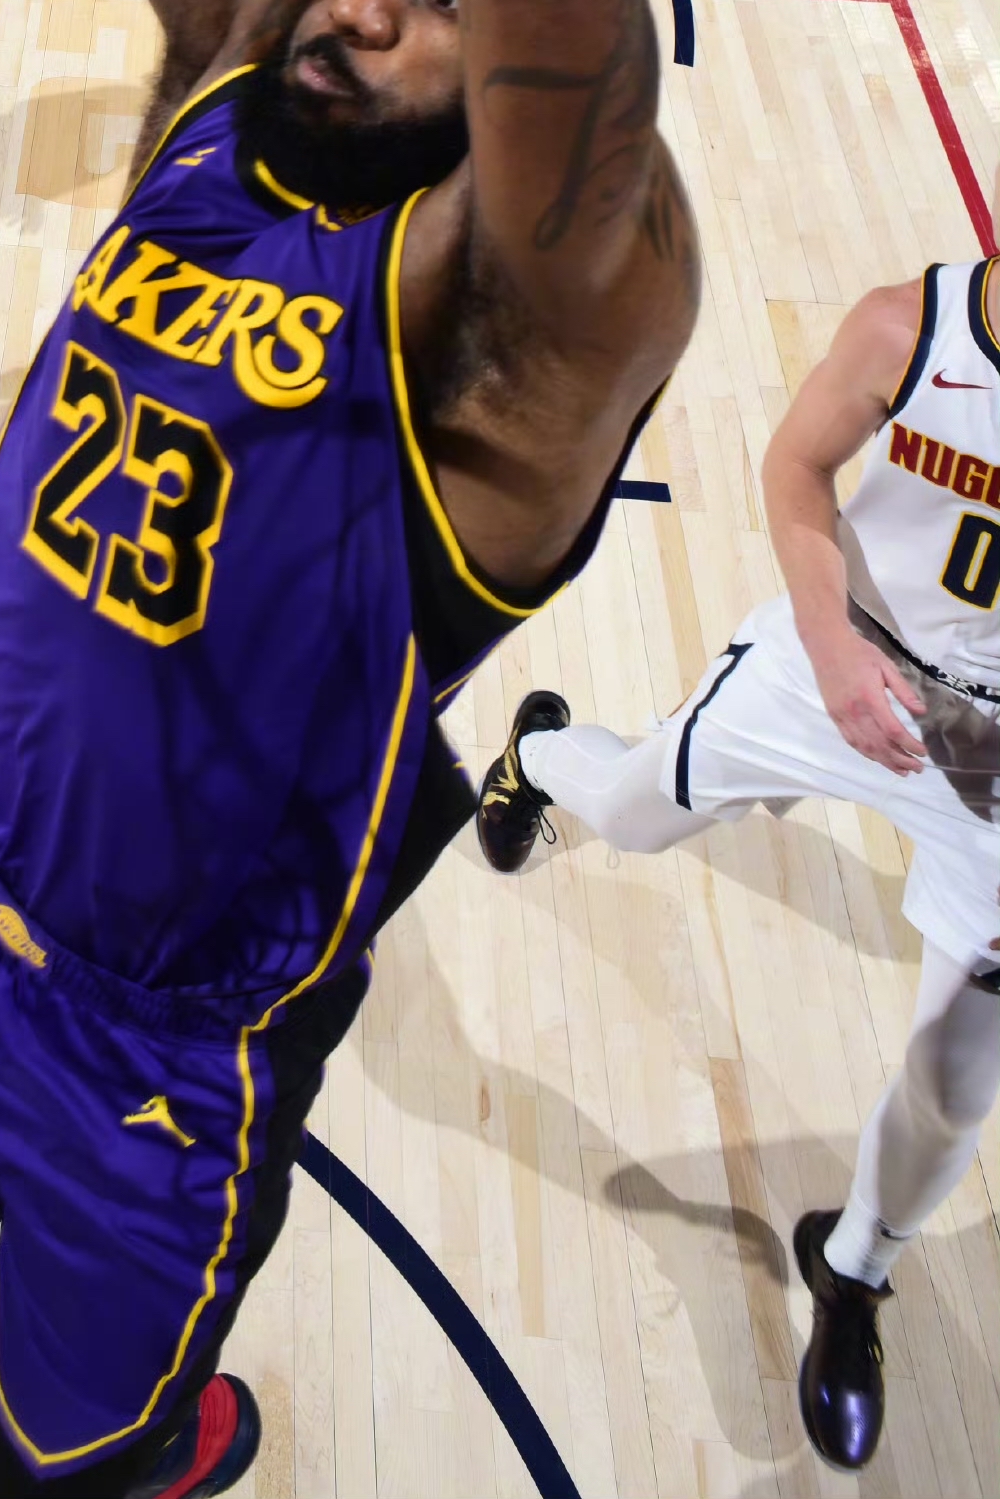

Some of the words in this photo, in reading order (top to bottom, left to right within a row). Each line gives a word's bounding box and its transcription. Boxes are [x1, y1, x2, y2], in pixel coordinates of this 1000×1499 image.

[71, 224, 345, 410] AKERS
[20, 339, 234, 648] 23
[939, 510, 1000, 611] 0
